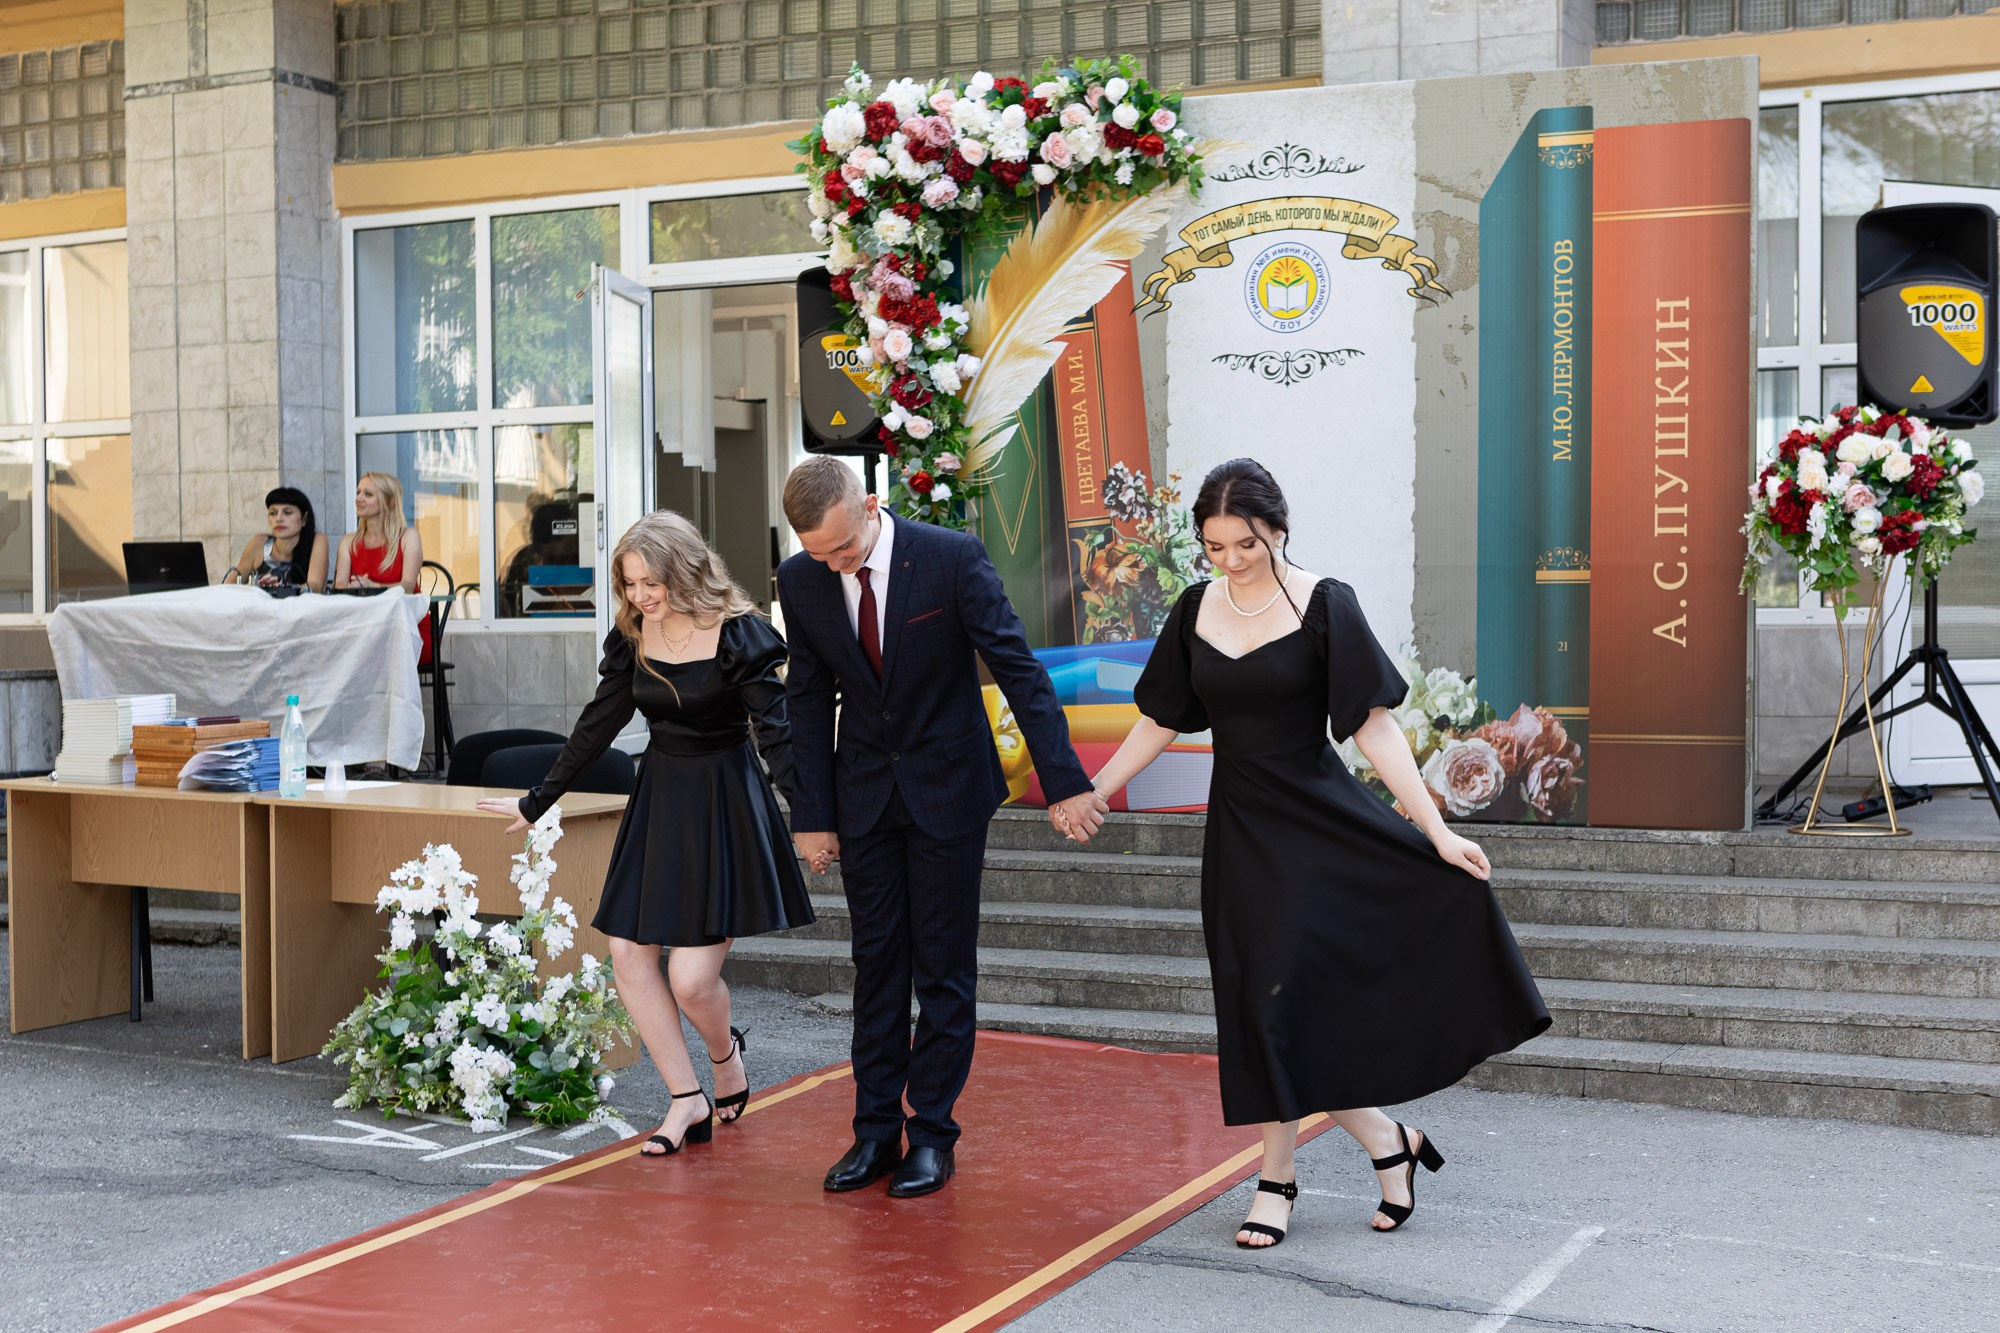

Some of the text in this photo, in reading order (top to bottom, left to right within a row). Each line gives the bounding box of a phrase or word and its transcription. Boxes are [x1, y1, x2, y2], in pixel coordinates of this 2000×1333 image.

[1193, 225, 1210, 242] ТОТ
[1211, 213, 1245, 234] САМЫЙ
[1276, 208, 1321, 220] КОТОРОГО
[1323, 209, 1340, 221] МЫ
[1272, 247, 1301, 256] имени
[1910, 303, 1975, 324] 1000
[1273, 319, 1301, 330] ГБОУ
[826, 349, 864, 368] 100
[1552, 238, 1573, 462] М.Ю.ЛЕРМОНТОВ
[849, 366, 874, 374] WATTS
[1068, 349, 1098, 505] ЦВЕТАЕВА М.И.
[1652, 296, 1690, 648] А.С.ПУШКИН
[1557, 641, 1568, 652] 21
